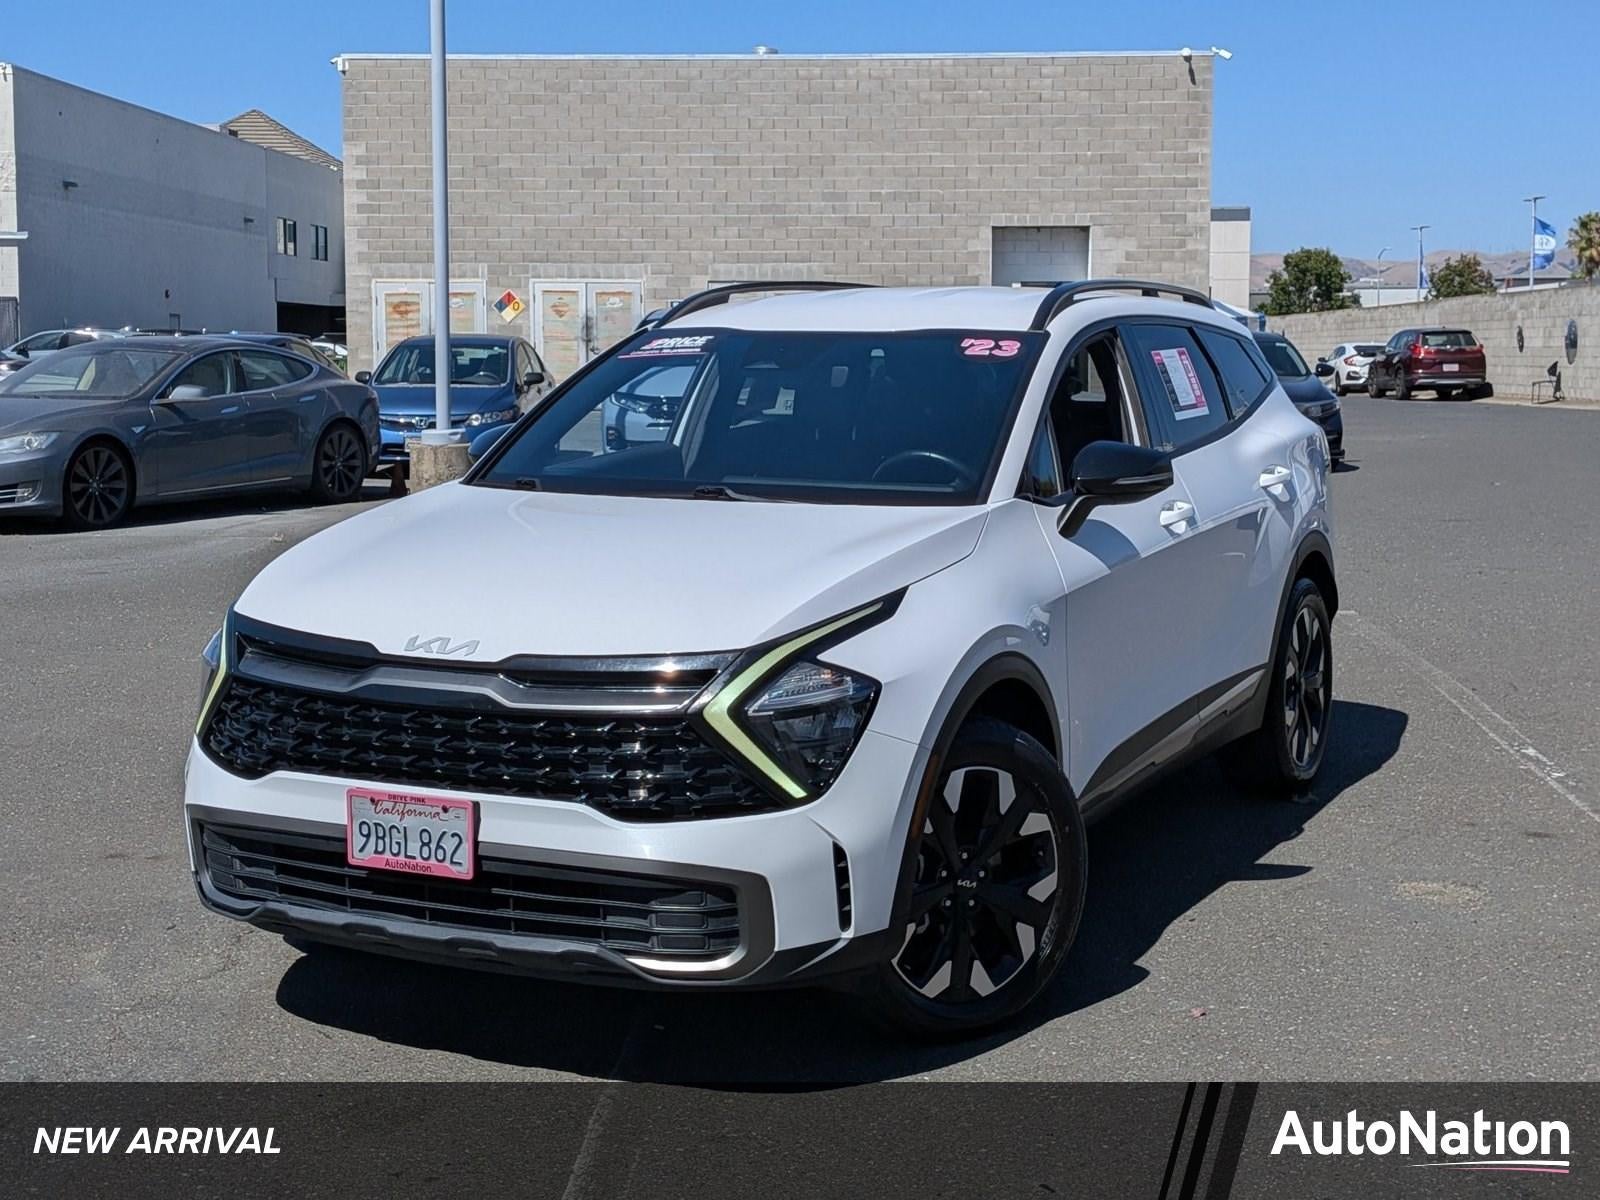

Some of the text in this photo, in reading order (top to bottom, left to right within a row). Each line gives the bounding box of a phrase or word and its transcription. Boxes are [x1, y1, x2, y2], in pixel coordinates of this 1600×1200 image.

[961, 338, 1021, 357] '23
[374, 799, 442, 822] California
[358, 820, 463, 867] 9BGL862
[384, 858, 433, 873] AutoNation
